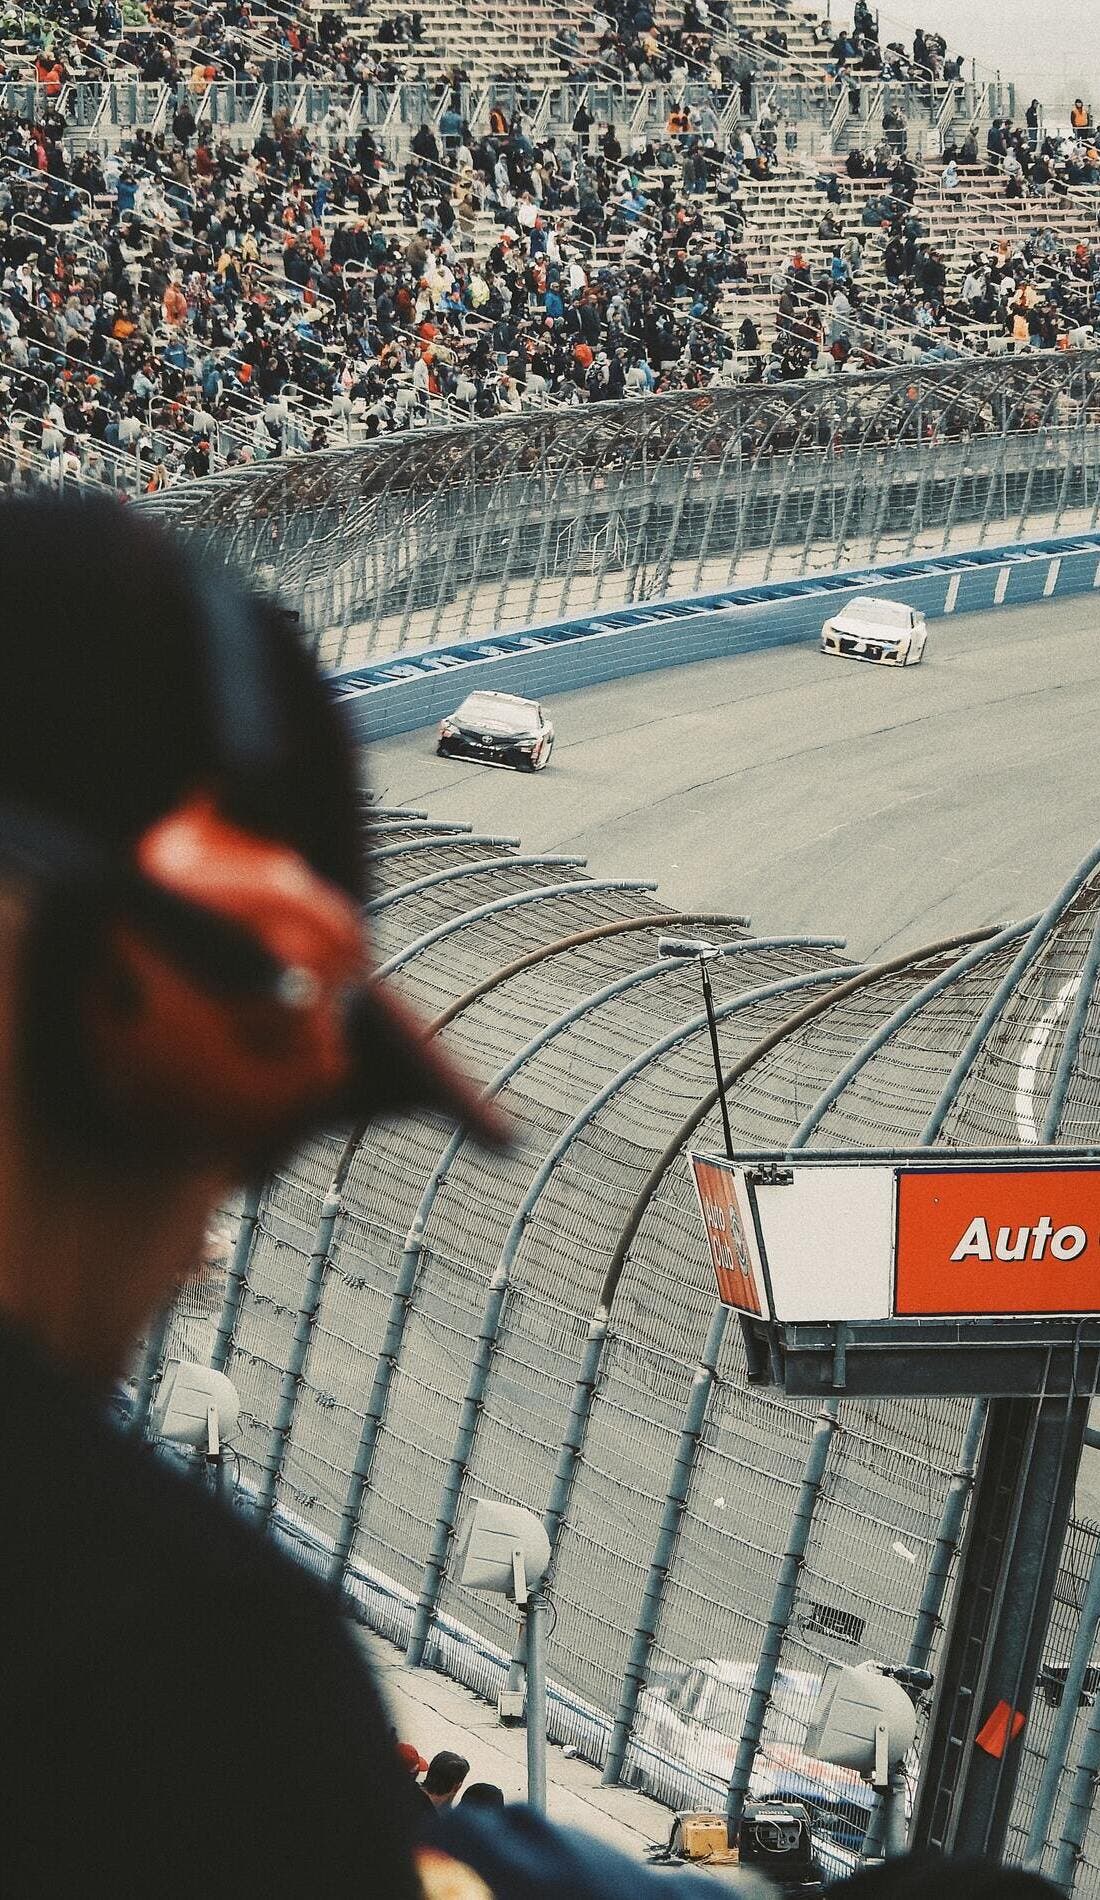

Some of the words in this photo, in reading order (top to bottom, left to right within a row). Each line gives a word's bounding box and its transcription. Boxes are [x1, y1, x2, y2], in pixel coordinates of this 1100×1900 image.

[704, 1196, 726, 1232] Auto
[713, 1234, 735, 1271] Club
[949, 1216, 1087, 1261] Auto
